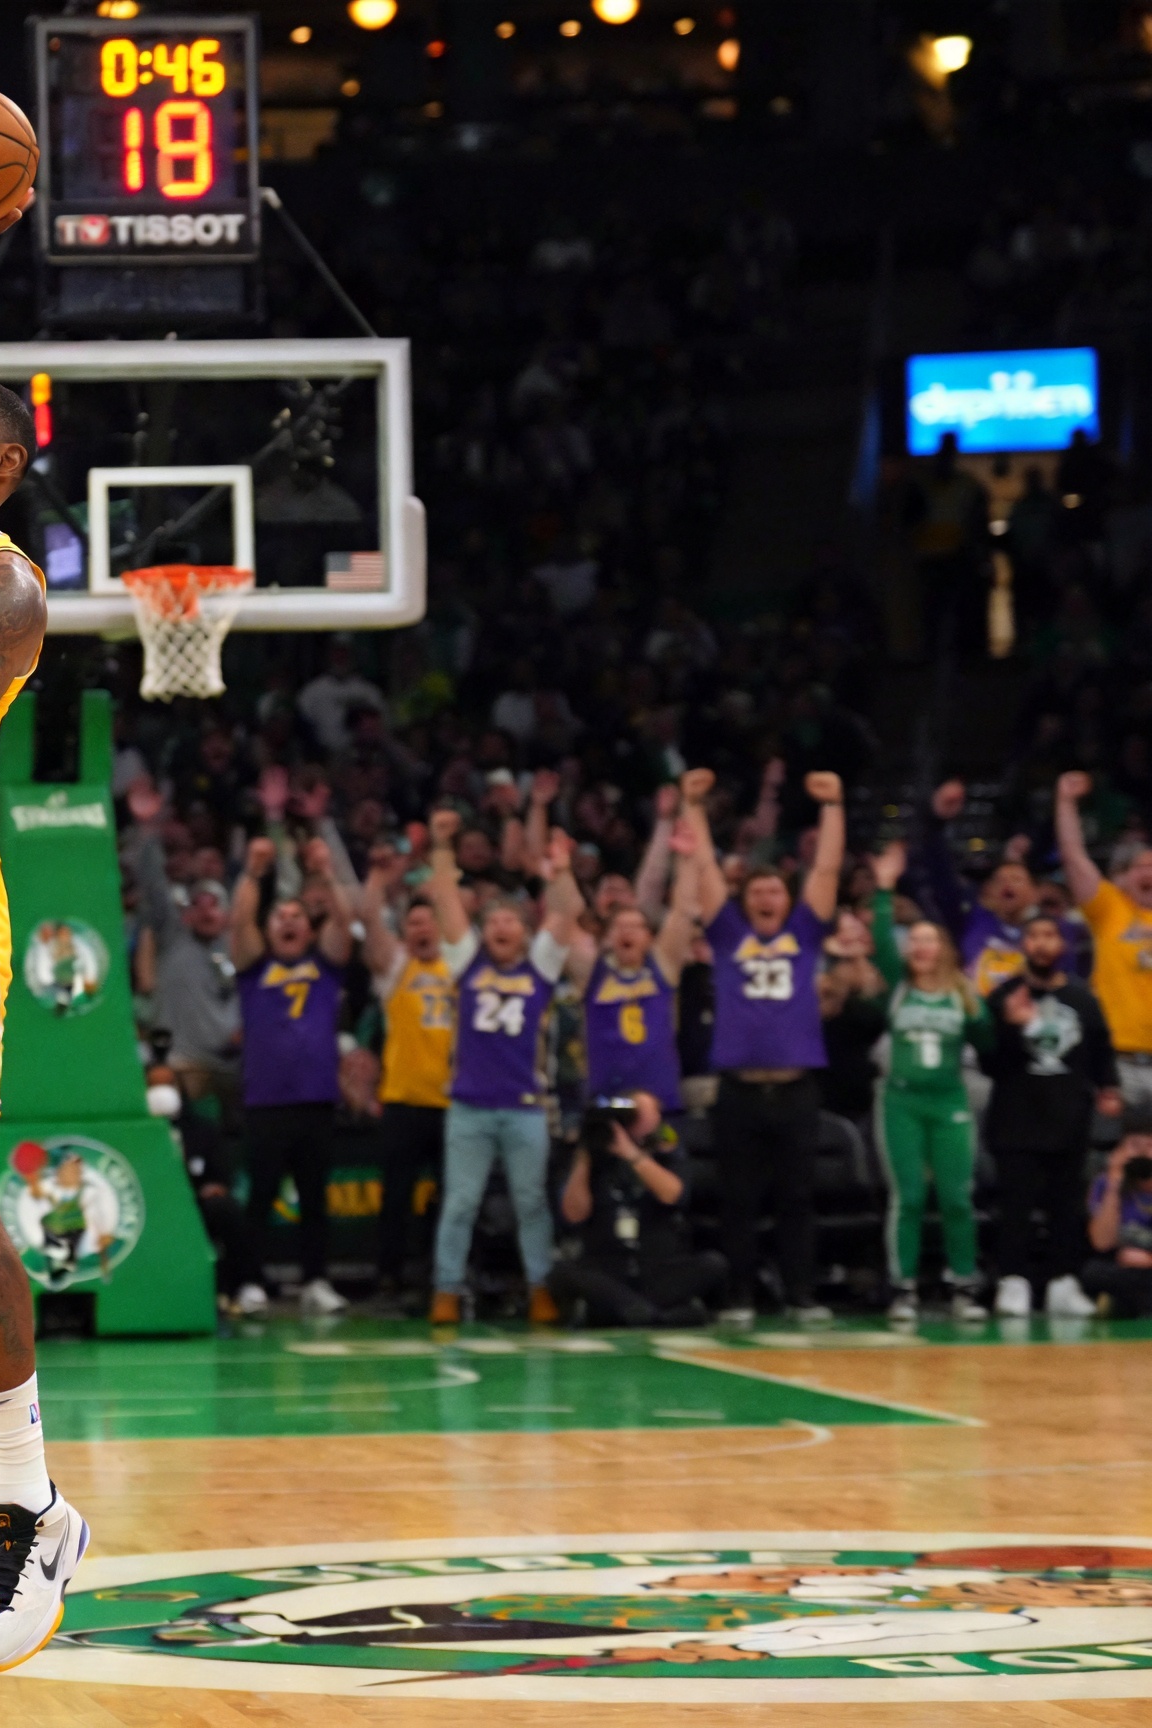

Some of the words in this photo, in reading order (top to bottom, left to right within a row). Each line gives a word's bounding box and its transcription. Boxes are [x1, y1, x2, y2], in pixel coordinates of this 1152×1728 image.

[100, 38, 226, 97] 0:46
[122, 99, 214, 201] 18
[111, 213, 246, 245] TISSOT
[282, 981, 311, 1020] 7
[472, 990, 526, 1037] 24
[619, 1003, 647, 1045] 6
